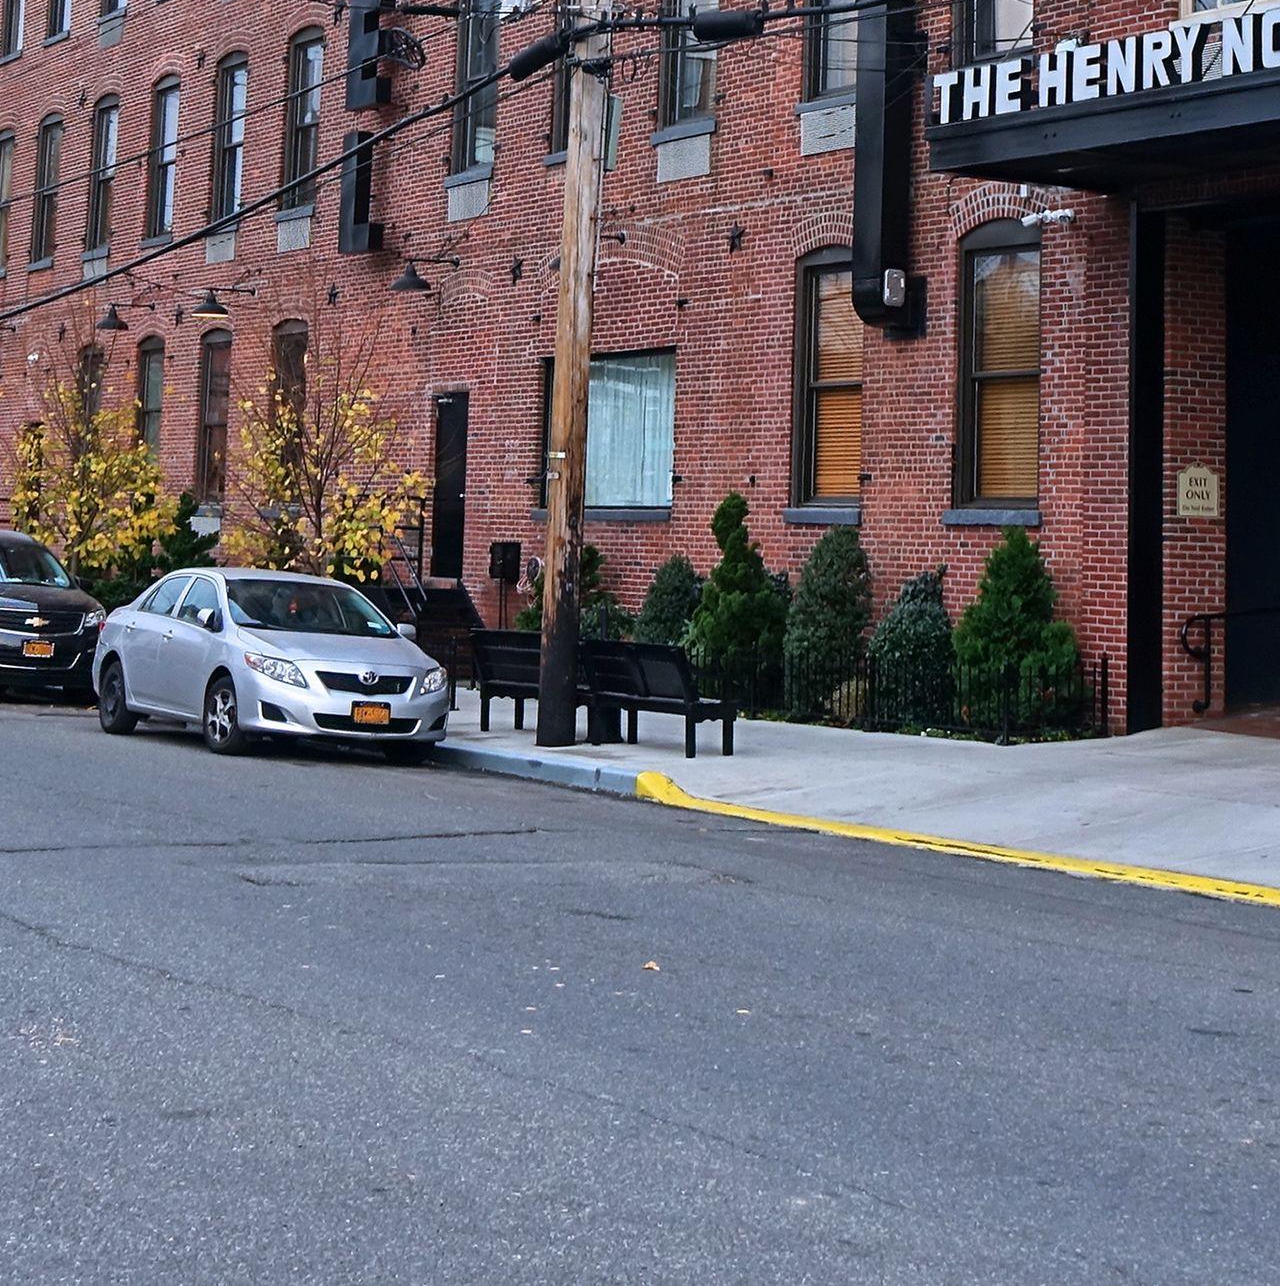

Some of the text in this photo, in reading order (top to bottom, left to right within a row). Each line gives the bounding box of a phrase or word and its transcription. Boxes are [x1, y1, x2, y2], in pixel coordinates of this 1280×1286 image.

[933, 60, 1021, 125] THE
[1039, 23, 1201, 108] HENRY
[1189, 477, 1207, 487] EXIT
[1185, 489, 1210, 501] ONLY
